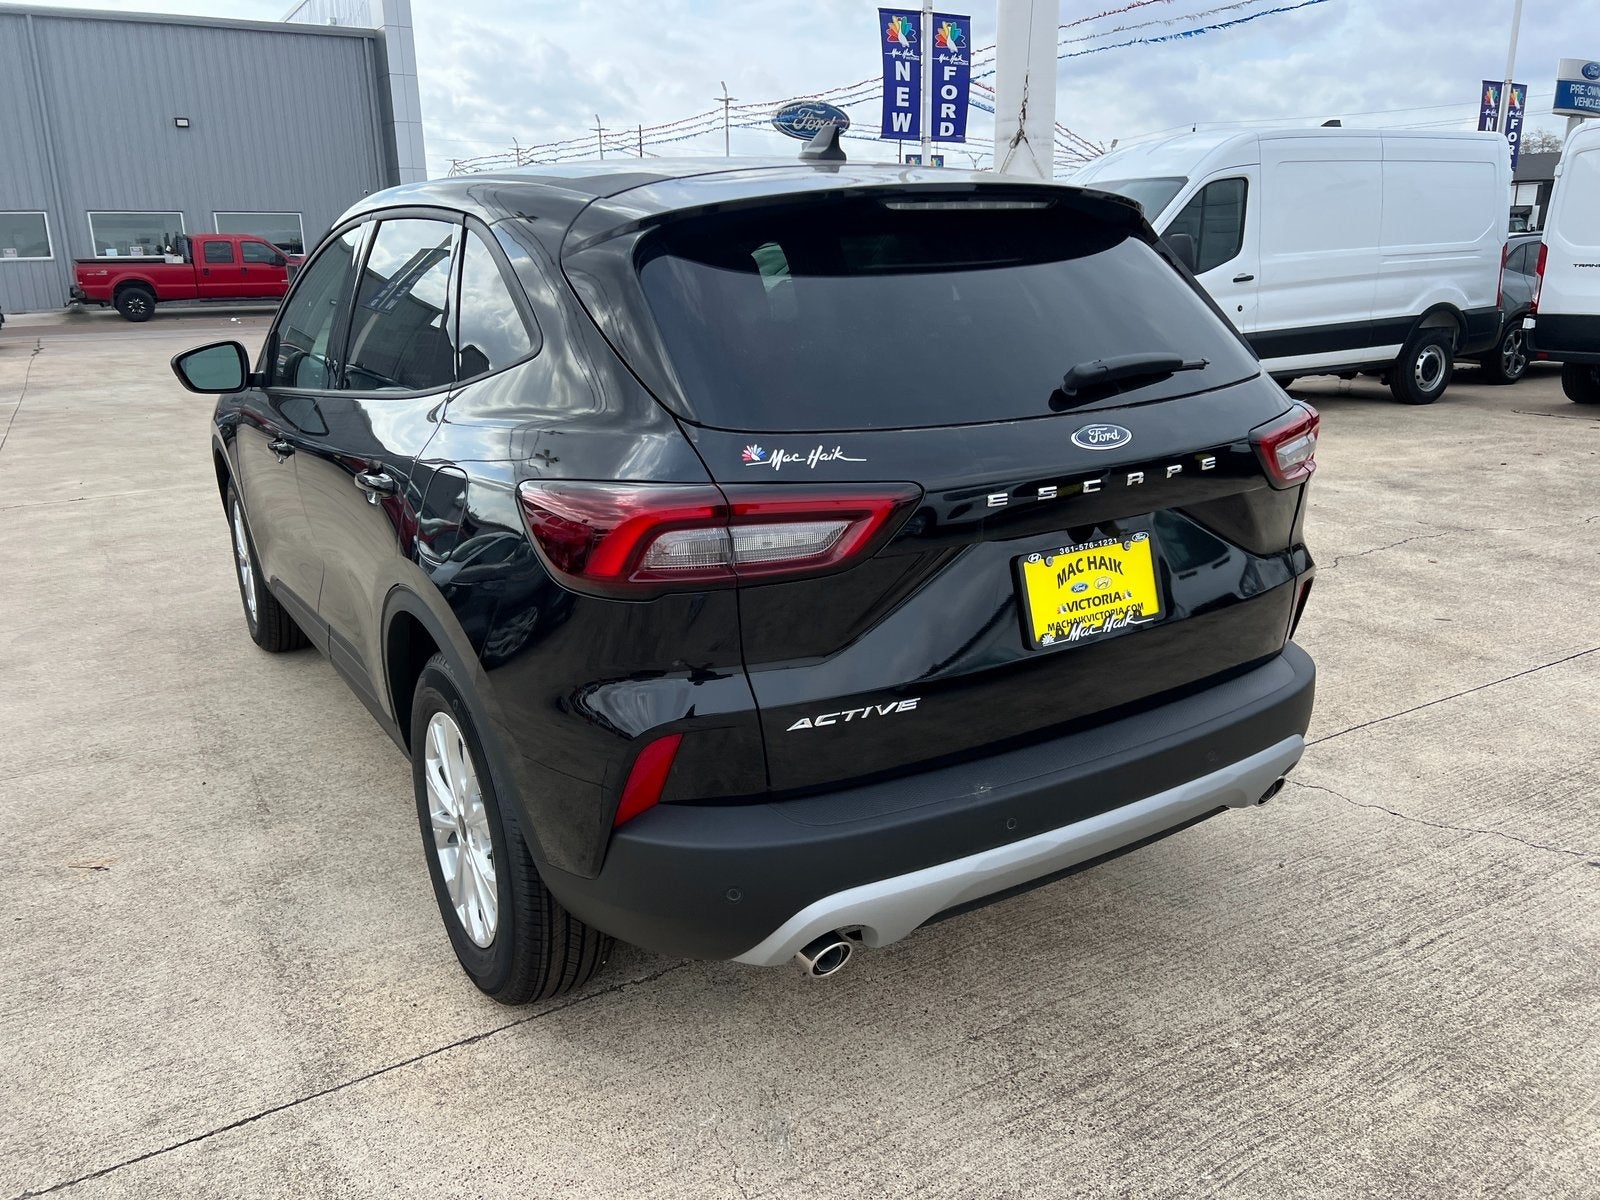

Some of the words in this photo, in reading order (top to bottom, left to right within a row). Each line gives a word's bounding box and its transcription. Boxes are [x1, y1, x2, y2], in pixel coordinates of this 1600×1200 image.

[892, 61, 912, 132] NEW
[940, 66, 958, 136] FORD
[1088, 427, 1121, 443] Ford
[747, 449, 806, 471] Mac
[807, 445, 866, 469] Haik
[987, 456, 1216, 508] ESCAPE
[1059, 537, 1118, 555] 361-576-1221
[1057, 558, 1084, 589] MAC
[1086, 555, 1124, 575] HAIK
[1047, 602, 1144, 631] MACHAIKVICTORIA.COM
[1066, 592, 1122, 613] VICTORIA
[1056, 622, 1102, 643] Mac
[1103, 611, 1150, 633] Haik
[785, 697, 922, 732] ACTIVE
